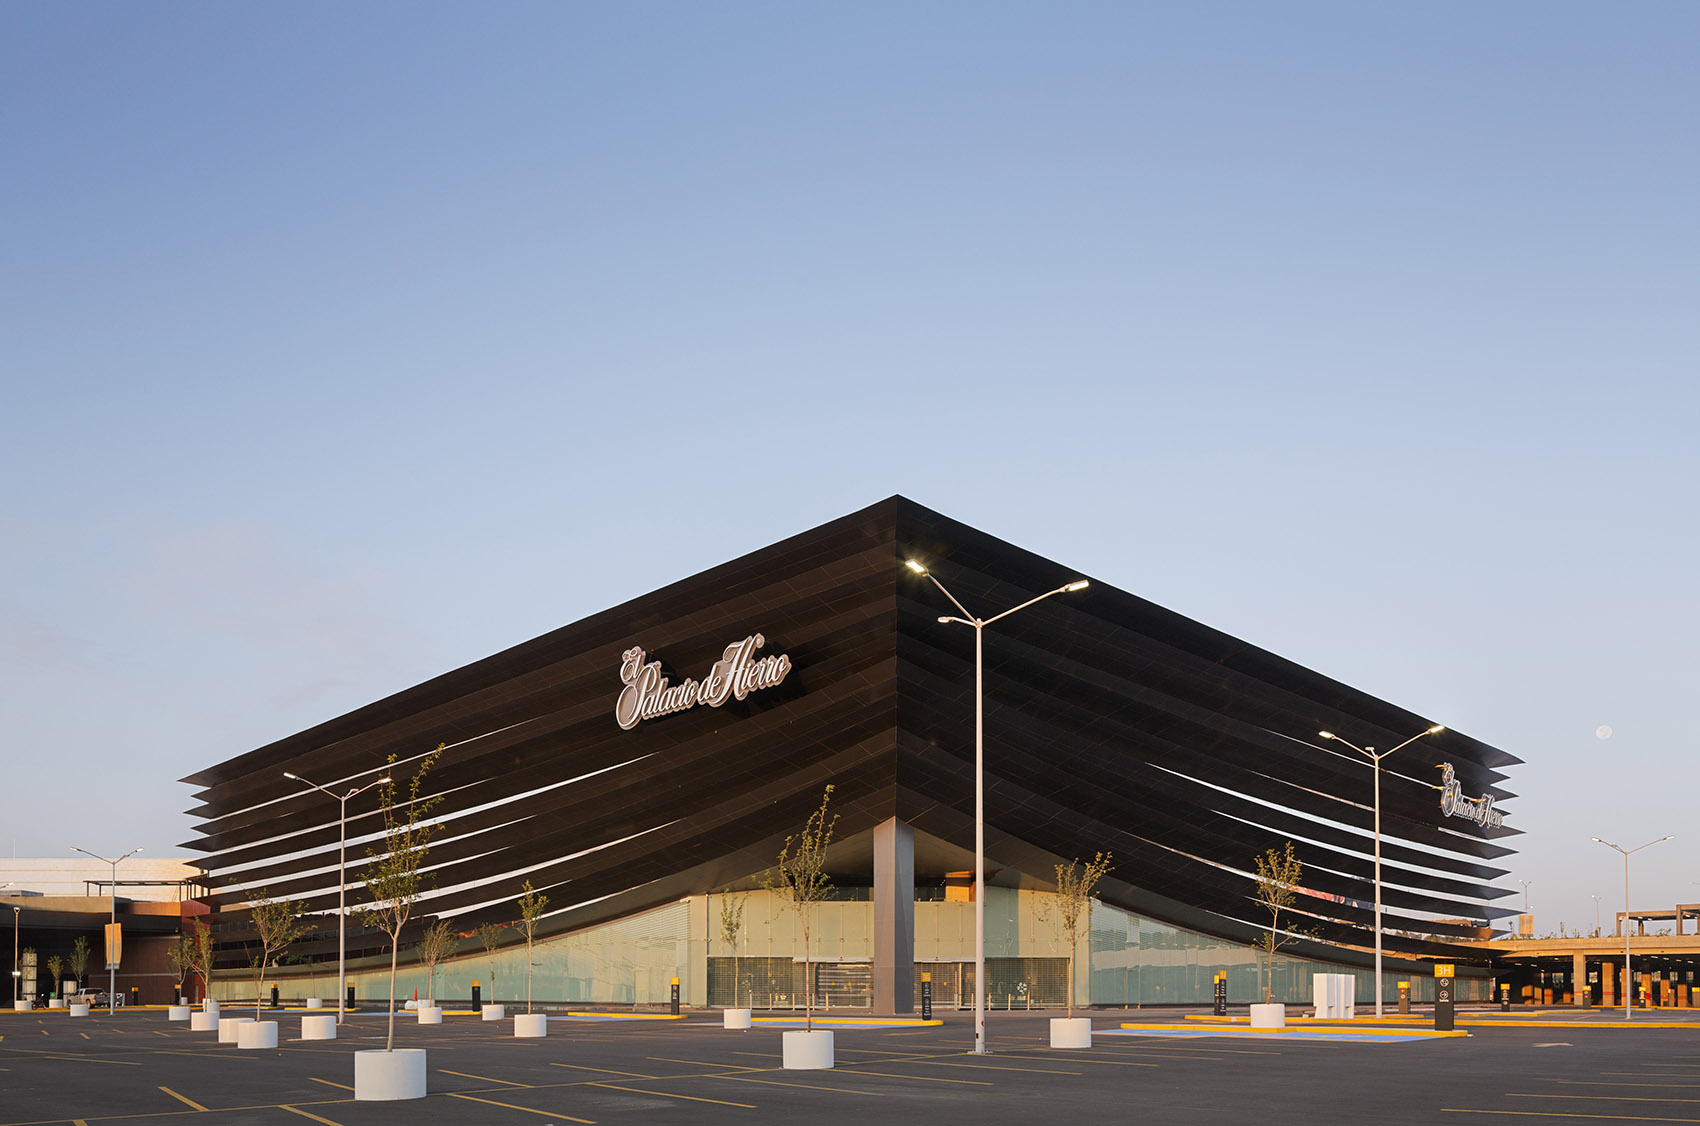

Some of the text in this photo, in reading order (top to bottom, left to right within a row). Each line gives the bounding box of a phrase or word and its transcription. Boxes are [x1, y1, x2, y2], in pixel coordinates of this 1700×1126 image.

[616, 633, 792, 730] Palacio de Hierro
[620, 646, 646, 684] El
[1437, 966, 1451, 975] 3H
